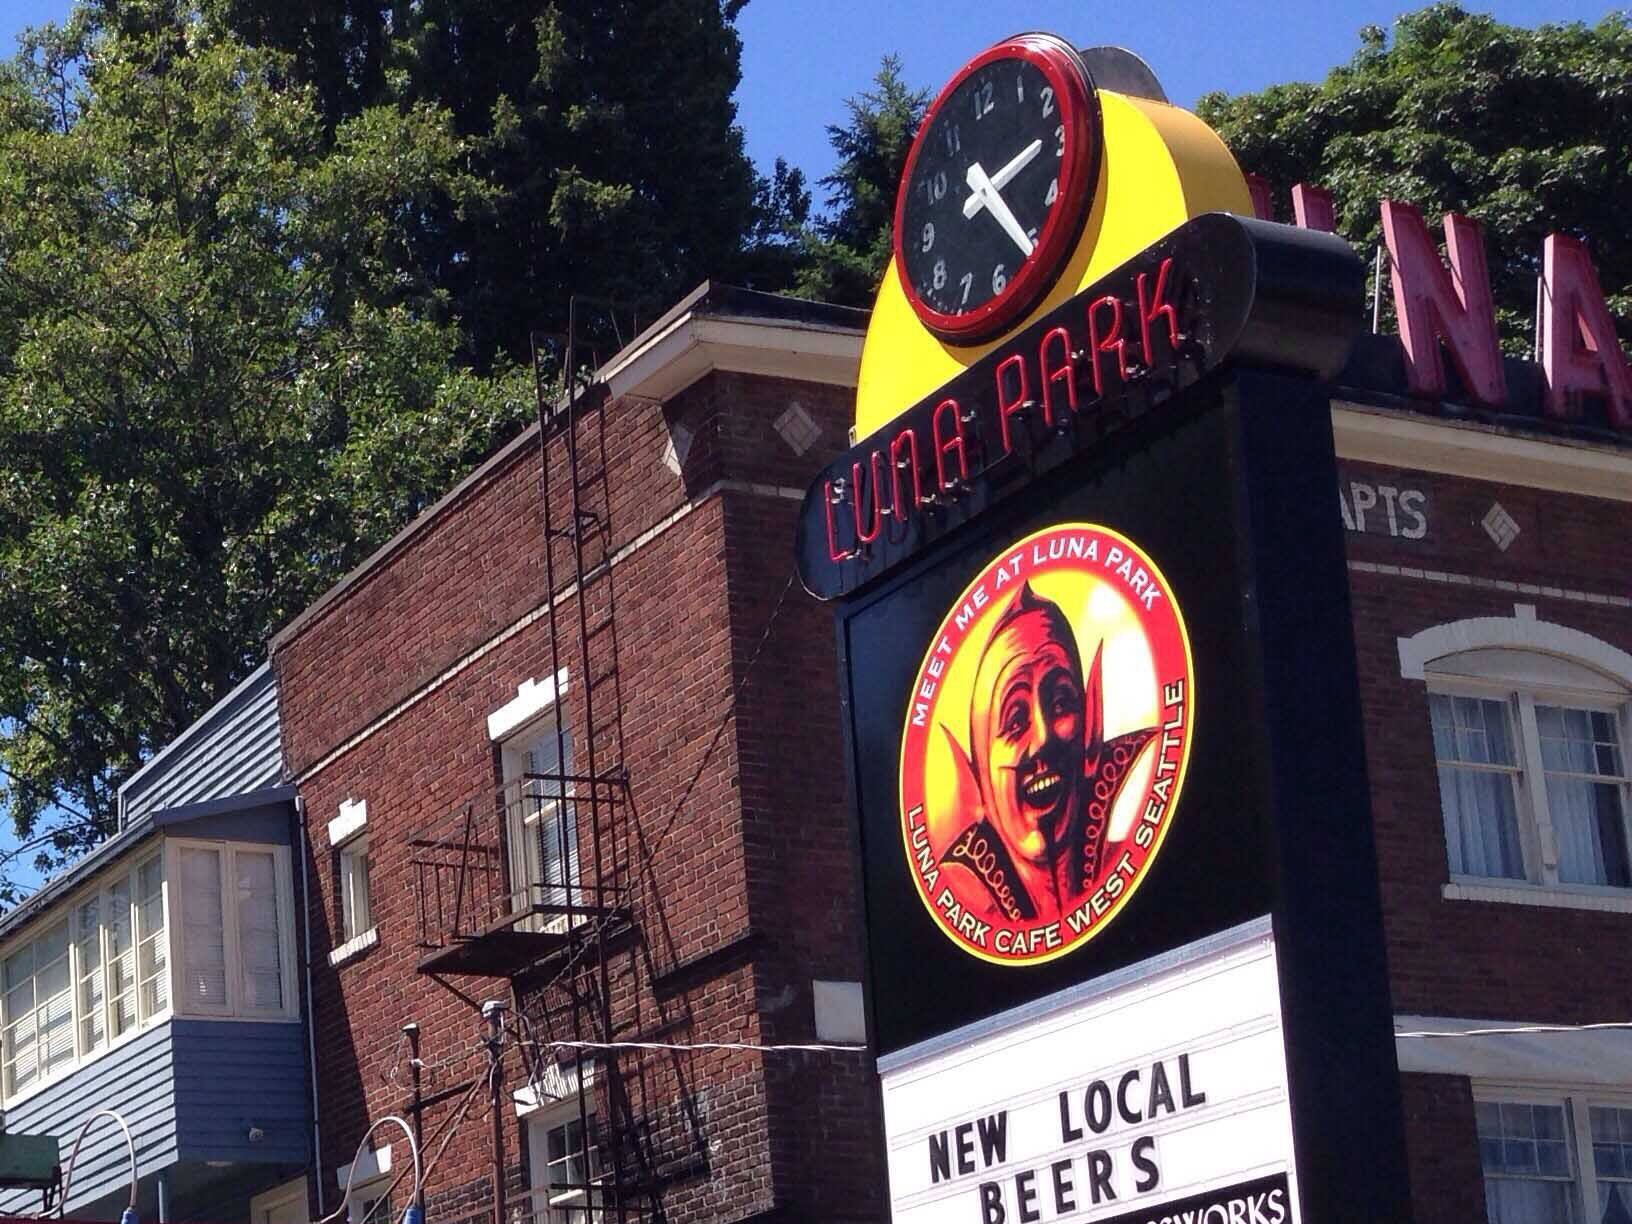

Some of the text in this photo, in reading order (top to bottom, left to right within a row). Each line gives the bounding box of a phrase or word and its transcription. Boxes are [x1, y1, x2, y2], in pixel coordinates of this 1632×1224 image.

[974, 81, 995, 120] 12
[1040, 87, 1054, 118] 2
[1054, 124, 1065, 157] 3
[1044, 177, 1059, 206] 4
[921, 222, 935, 252] 9
[932, 260, 947, 290] 8
[959, 272, 973, 304] 7
[992, 263, 1007, 296] 6
[825, 257, 1180, 562] LUNA PARK
[912, 536, 1163, 727] MEET ME AT LUNA PARK
[907, 679, 1185, 955] LUNA PARK CAFE WEST SEATTLE
[928, 1053, 1206, 1184] NEW LOCAL
